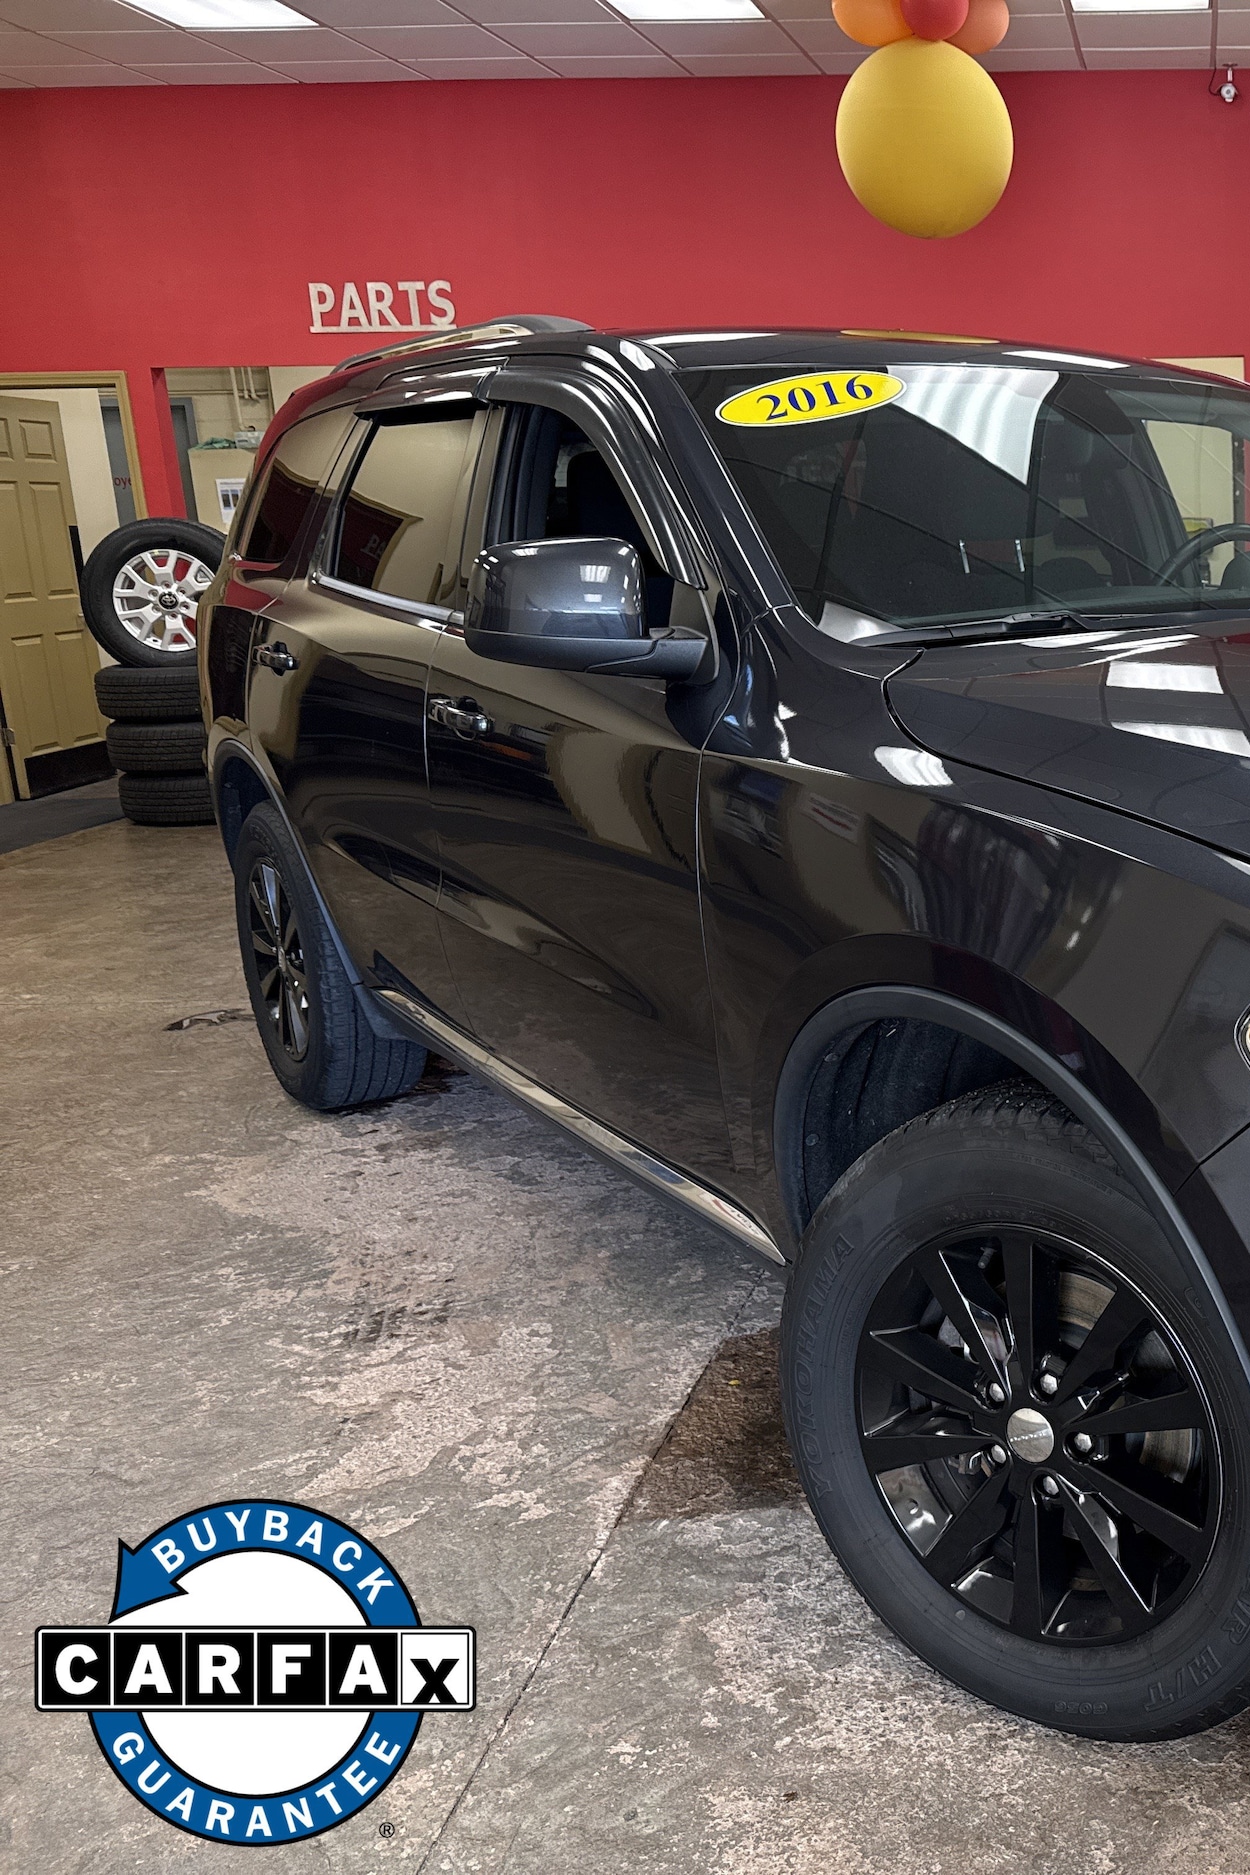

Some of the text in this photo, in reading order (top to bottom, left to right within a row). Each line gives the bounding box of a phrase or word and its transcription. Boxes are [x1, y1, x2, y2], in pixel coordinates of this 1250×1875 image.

[309, 280, 456, 328] PARTS
[756, 373, 874, 421] 2016
[794, 1232, 855, 1498] YOKOHAMA
